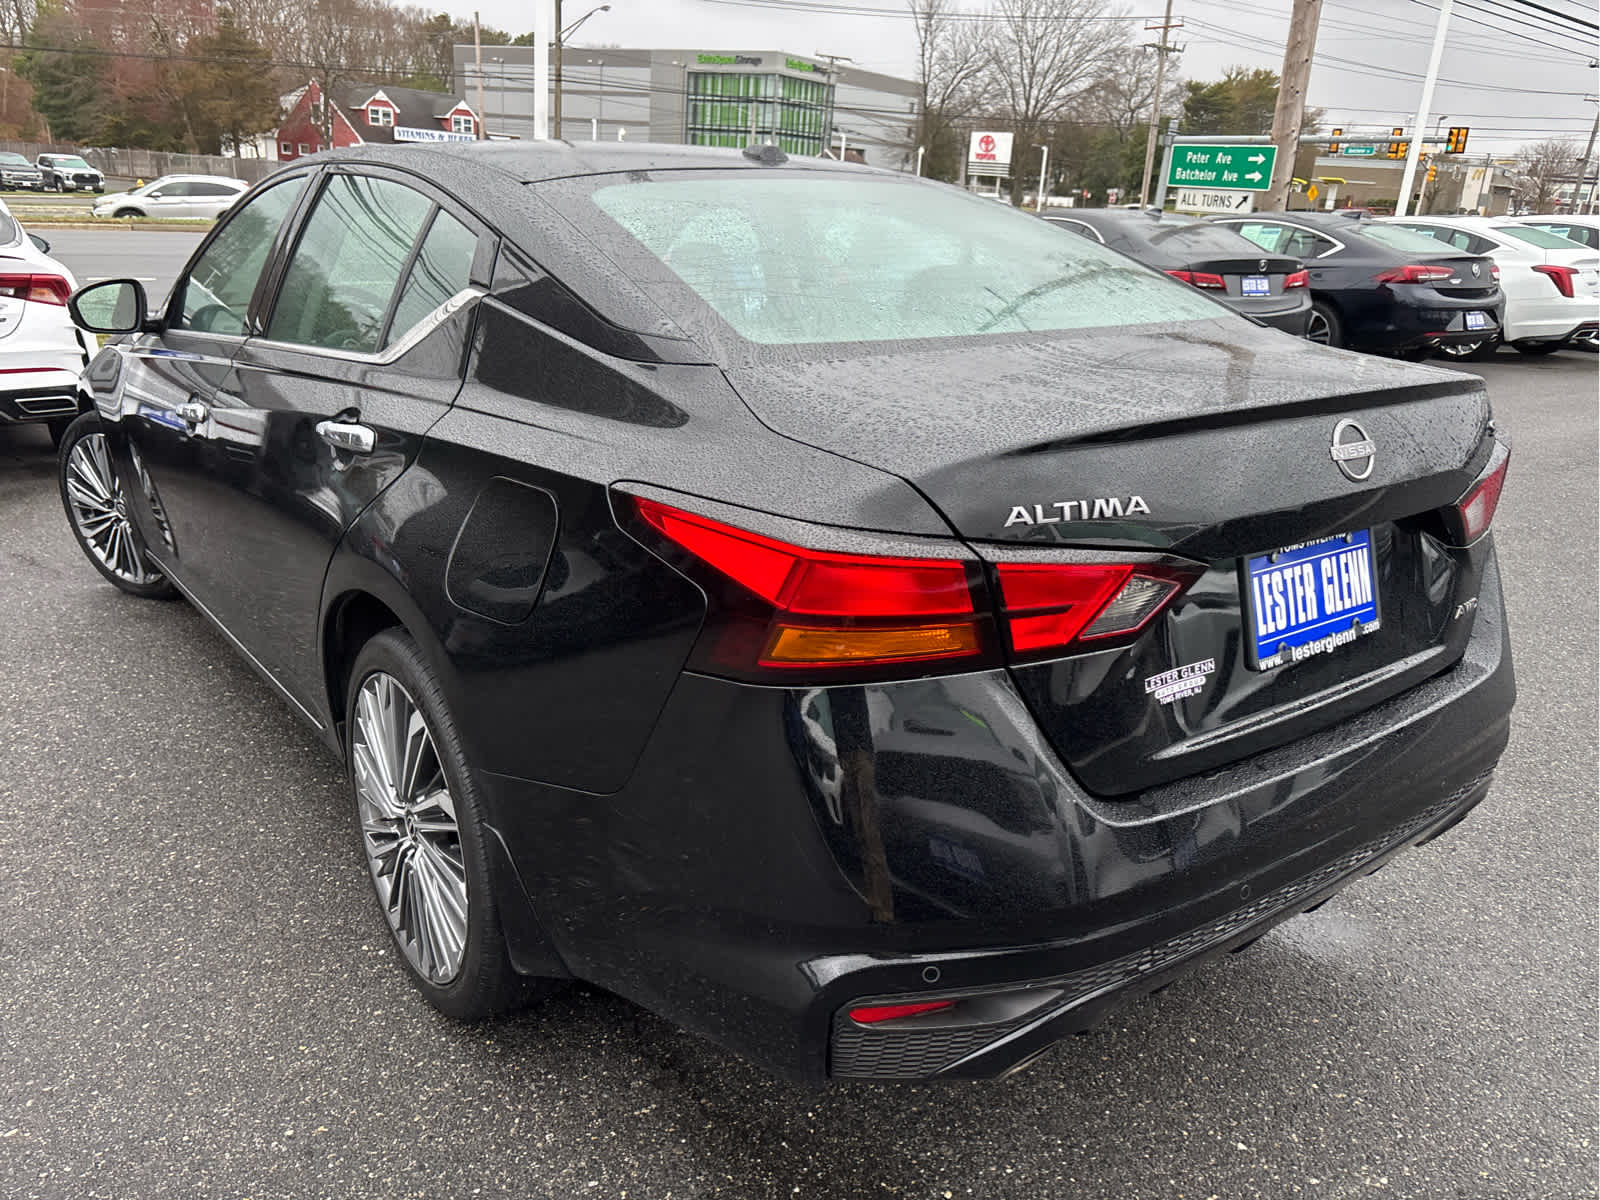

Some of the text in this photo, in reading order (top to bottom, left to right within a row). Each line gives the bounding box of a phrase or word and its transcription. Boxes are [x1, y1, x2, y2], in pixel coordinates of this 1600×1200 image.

[397, 129, 435, 141] VITAMINS
[438, 133, 444, 141] &
[1186, 151, 1232, 165] Peter Ave
[1175, 167, 1238, 182] Batchelor Ave
[1181, 192, 1232, 209] ALL TURNS
[1003, 495, 1151, 528] ALTIMA
[1253, 548, 1372, 637] LESTER GLENN
[1144, 660, 1215, 691] LESTER GLENN
